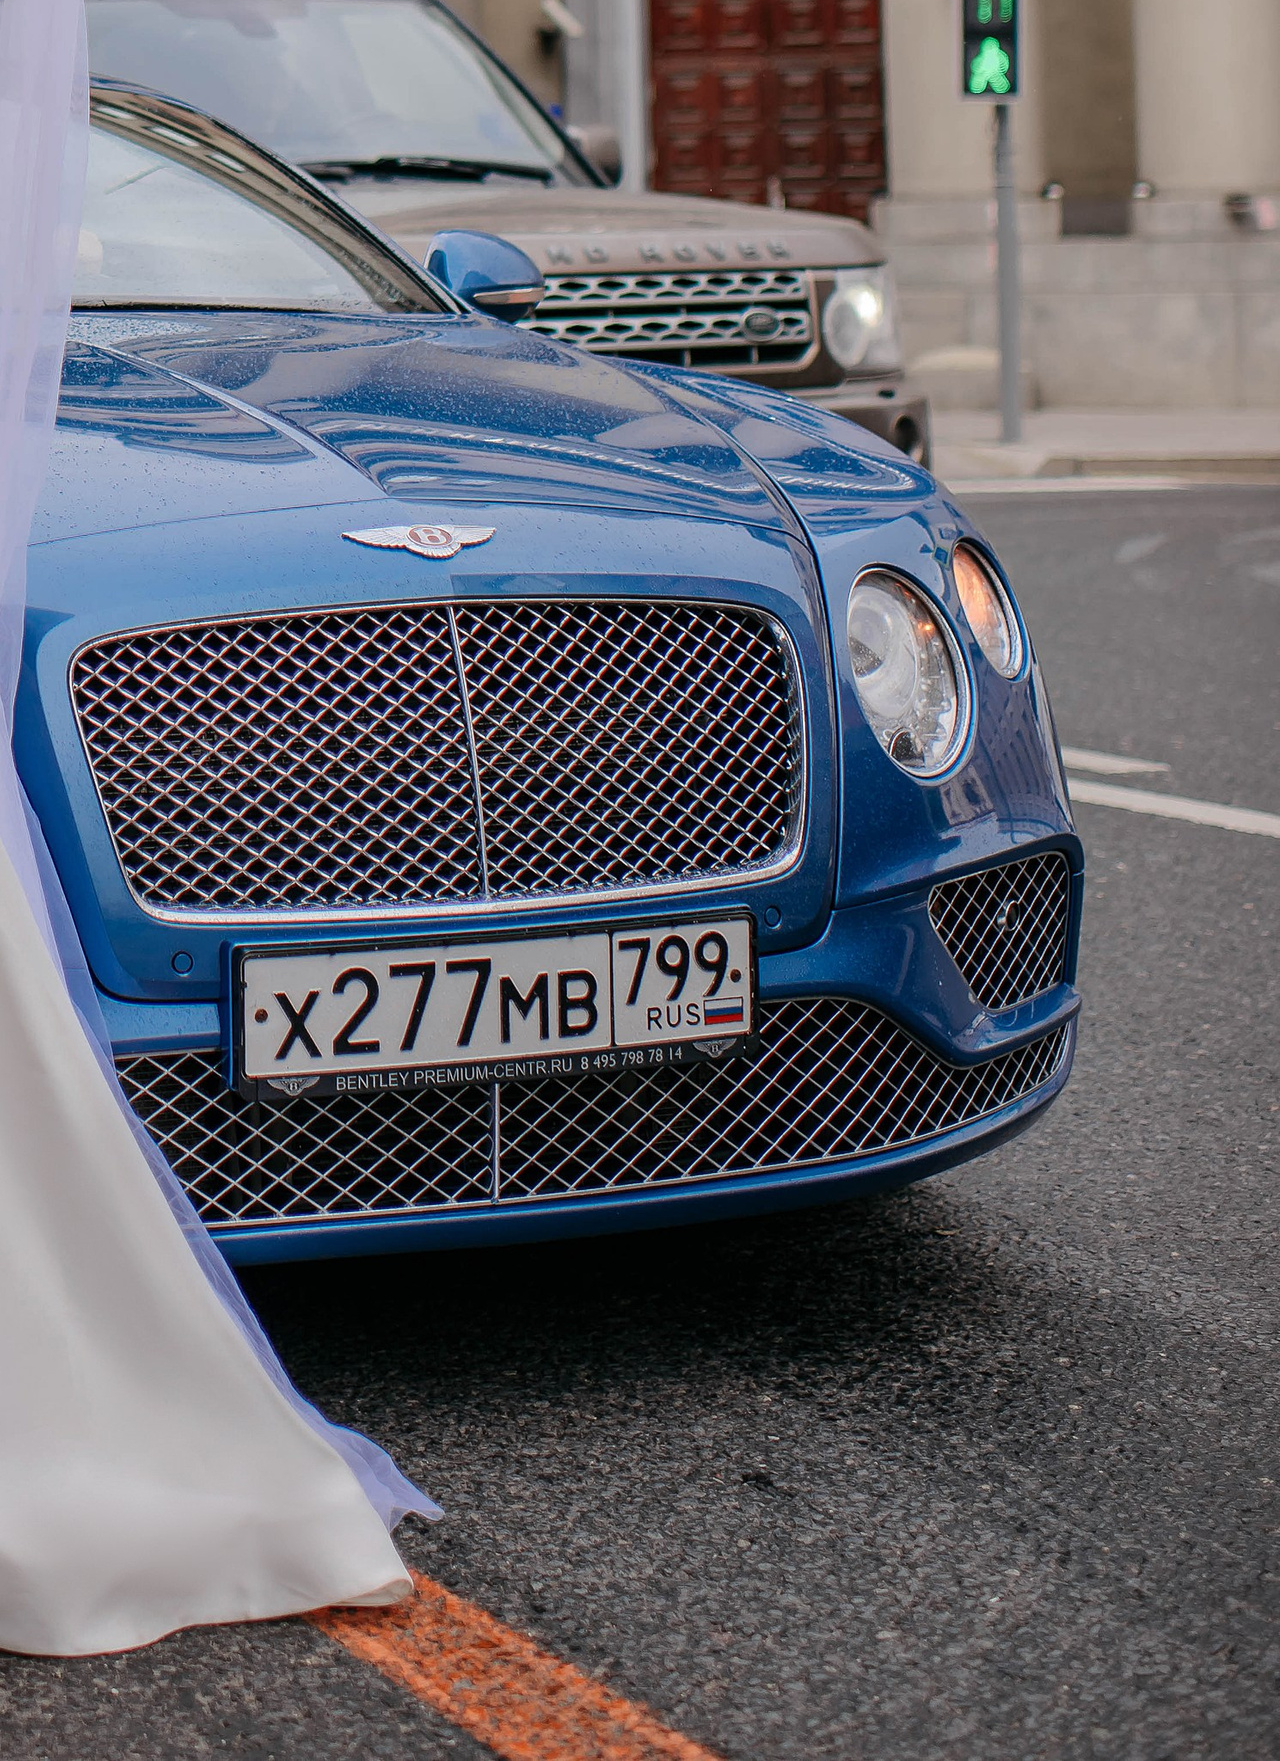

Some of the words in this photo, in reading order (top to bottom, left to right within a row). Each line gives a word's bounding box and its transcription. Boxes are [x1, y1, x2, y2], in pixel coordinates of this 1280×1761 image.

[616, 930, 731, 1006] 799
[274, 958, 599, 1061] Х277МВ
[647, 1001, 700, 1031] RUS
[335, 1071, 409, 1092] BENTLEY
[413, 1057, 573, 1086] PREMIUM-CENTR.RU
[580, 1055, 589, 1071] 8
[592, 1051, 617, 1069] 495
[621, 1050, 644, 1066] 798
[648, 1047, 663, 1063] 78
[669, 1046, 683, 1061] 14
